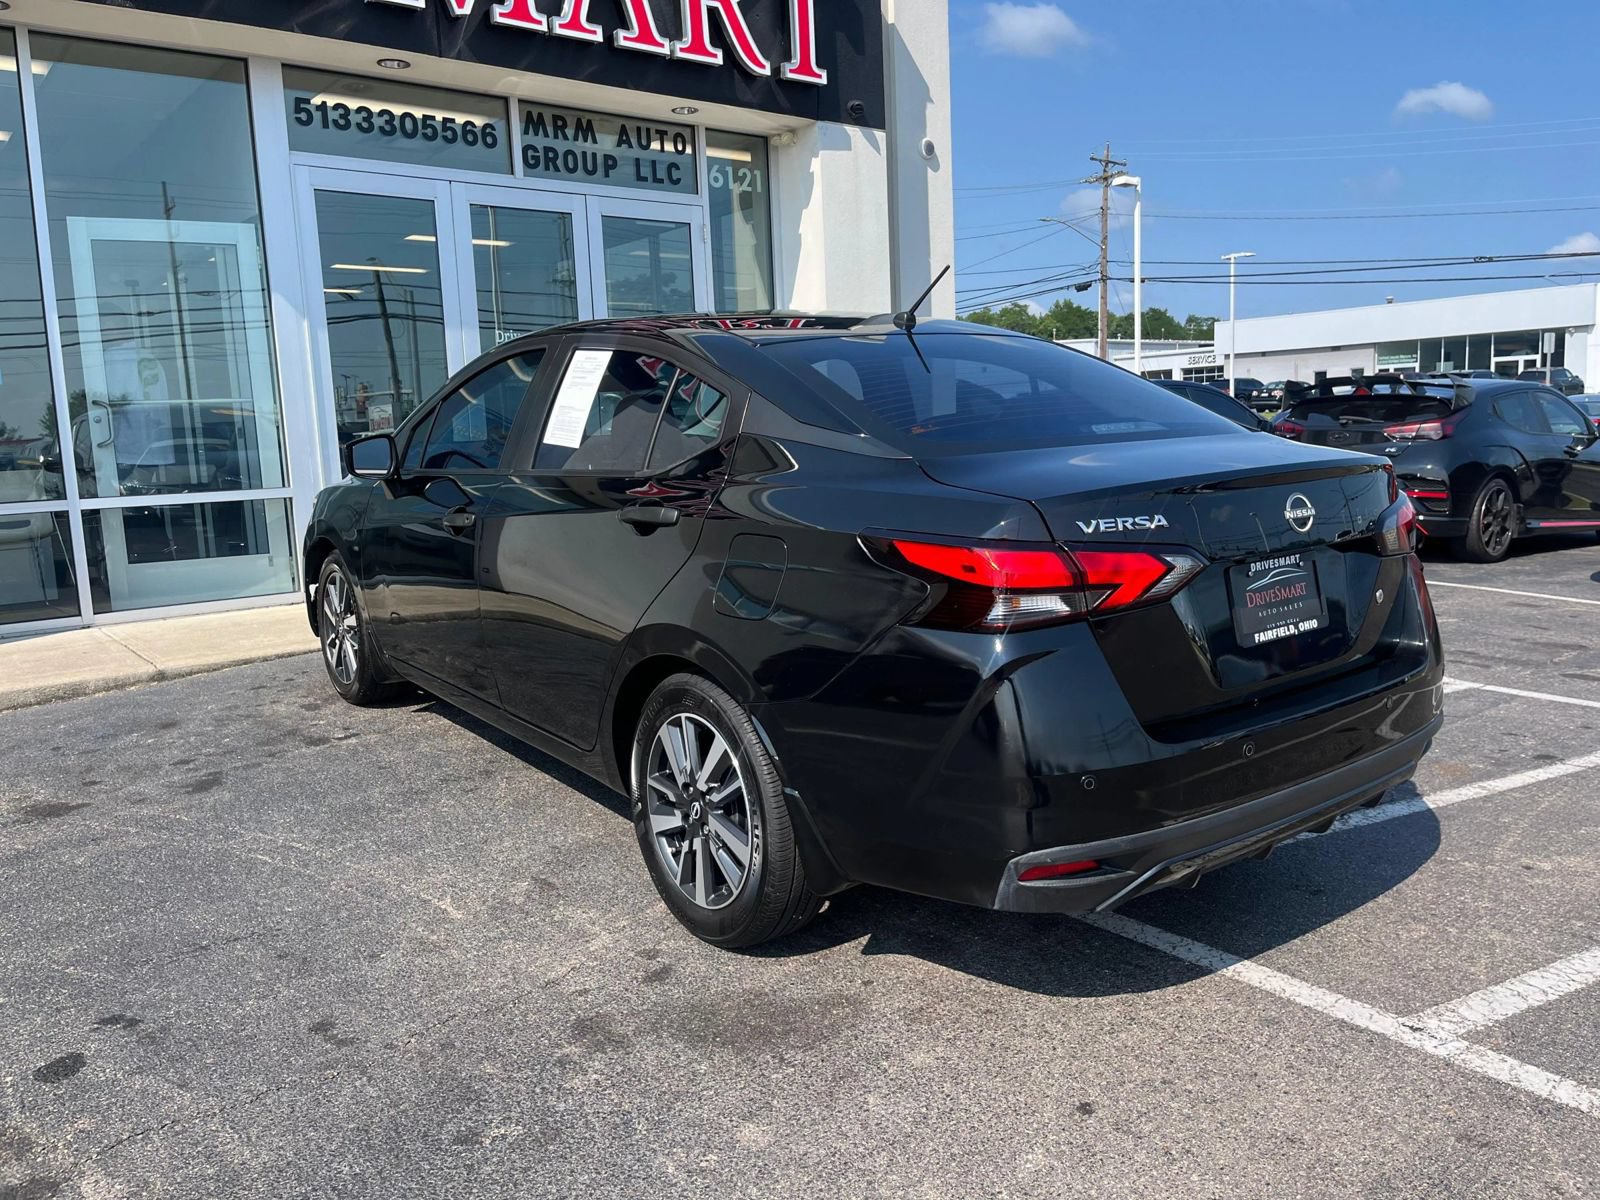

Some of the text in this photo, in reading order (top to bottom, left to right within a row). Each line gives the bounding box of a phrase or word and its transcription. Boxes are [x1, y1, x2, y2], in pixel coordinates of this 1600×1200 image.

[294, 97, 498, 149] 5133305566
[523, 110, 687, 155] MRM AUTO
[522, 144, 682, 185] GROUP LLC
[709, 164, 763, 193] 6121
[1187, 354, 1217, 366] SERVICE
[1076, 514, 1170, 534] VERSA
[1285, 507, 1316, 520] NISSAN
[1250, 554, 1301, 573] DRIVESMART
[1258, 601, 1303, 617] AUTO SALES
[1254, 623, 1298, 644] FAIRFIELD,
[1298, 618, 1318, 632] OHIO
